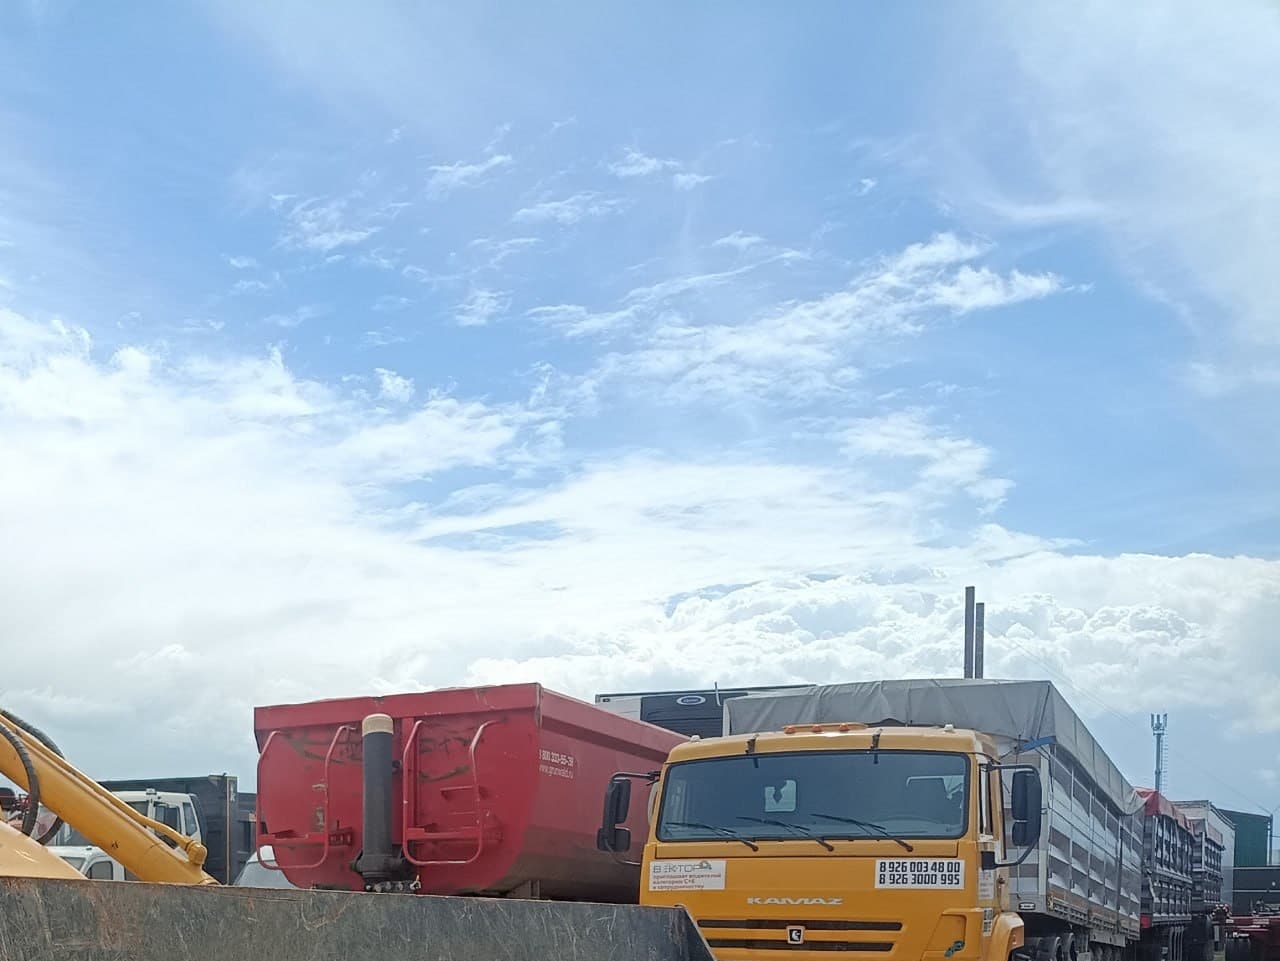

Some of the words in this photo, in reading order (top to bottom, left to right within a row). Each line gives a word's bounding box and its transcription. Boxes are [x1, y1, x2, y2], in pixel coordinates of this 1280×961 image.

[879, 861, 887, 873] 8
[888, 861, 908, 873] 926
[909, 861, 929, 873] 003
[930, 861, 945, 873] 48
[946, 861, 961, 873] 00
[879, 873, 886, 885] 8
[889, 873, 908, 885] 926
[911, 873, 937, 885] 3000
[940, 873, 960, 885] 995
[746, 896, 844, 906] KAMAZ
